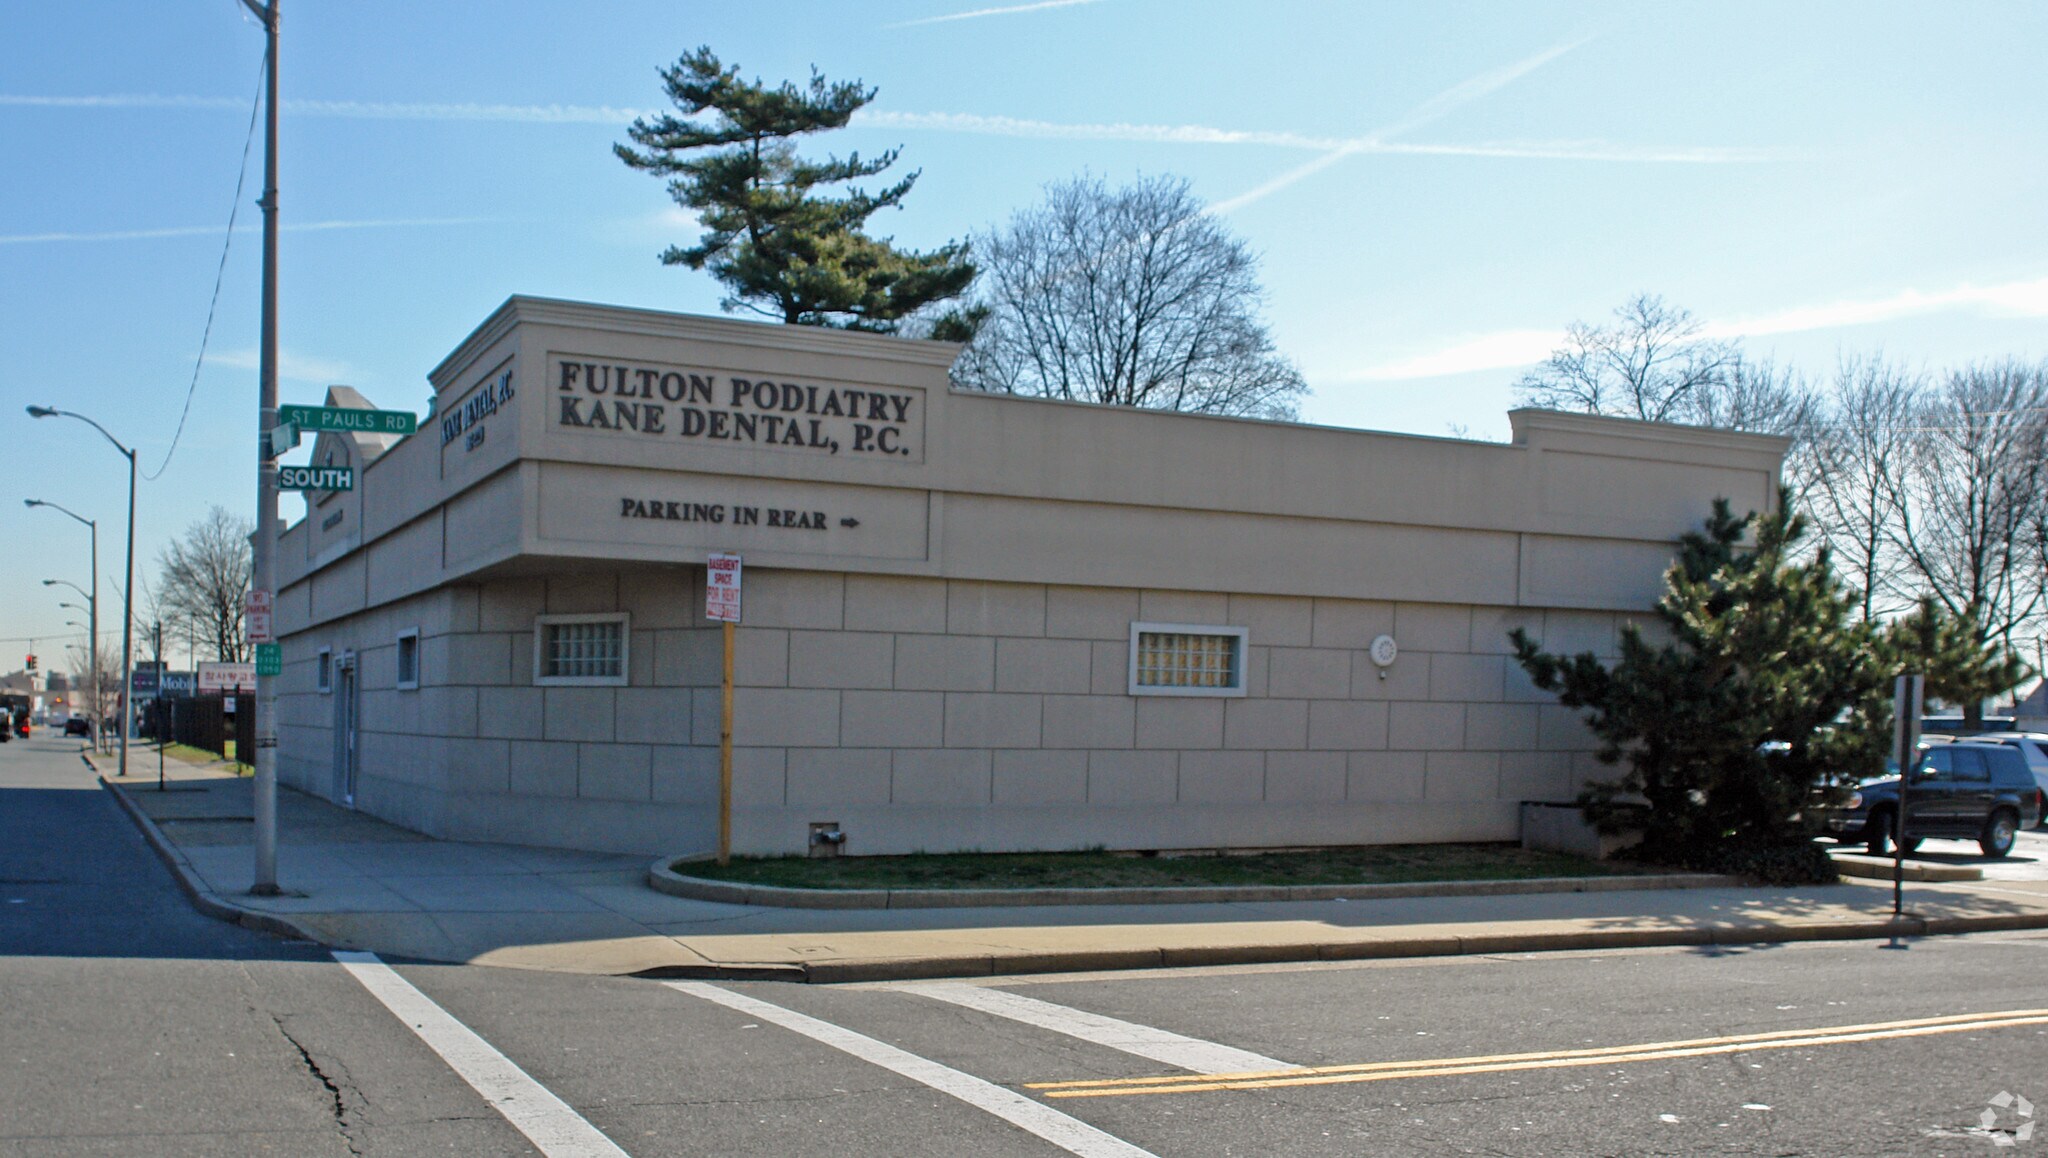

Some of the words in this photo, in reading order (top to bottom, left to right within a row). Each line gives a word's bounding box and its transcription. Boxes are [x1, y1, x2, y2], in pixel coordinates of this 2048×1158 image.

[558, 361, 714, 402] FULTON
[730, 378, 912, 422] PODIATRY
[291, 410, 310, 424] ST
[322, 412, 375, 428] PAULS
[386, 416, 406, 429] RD
[559, 397, 665, 434] KANE
[681, 408, 839, 455] DENTAL,
[852, 424, 909, 455] P.C.
[281, 469, 351, 488] SOUTH
[620, 498, 724, 524] PARKING
[733, 507, 759, 526] IN
[767, 509, 827, 530] REAR
[709, 558, 739, 571] BASEMENT
[714, 572, 733, 585] SPACE
[706, 586, 719, 600] FOR
[722, 588, 739, 602] RENT
